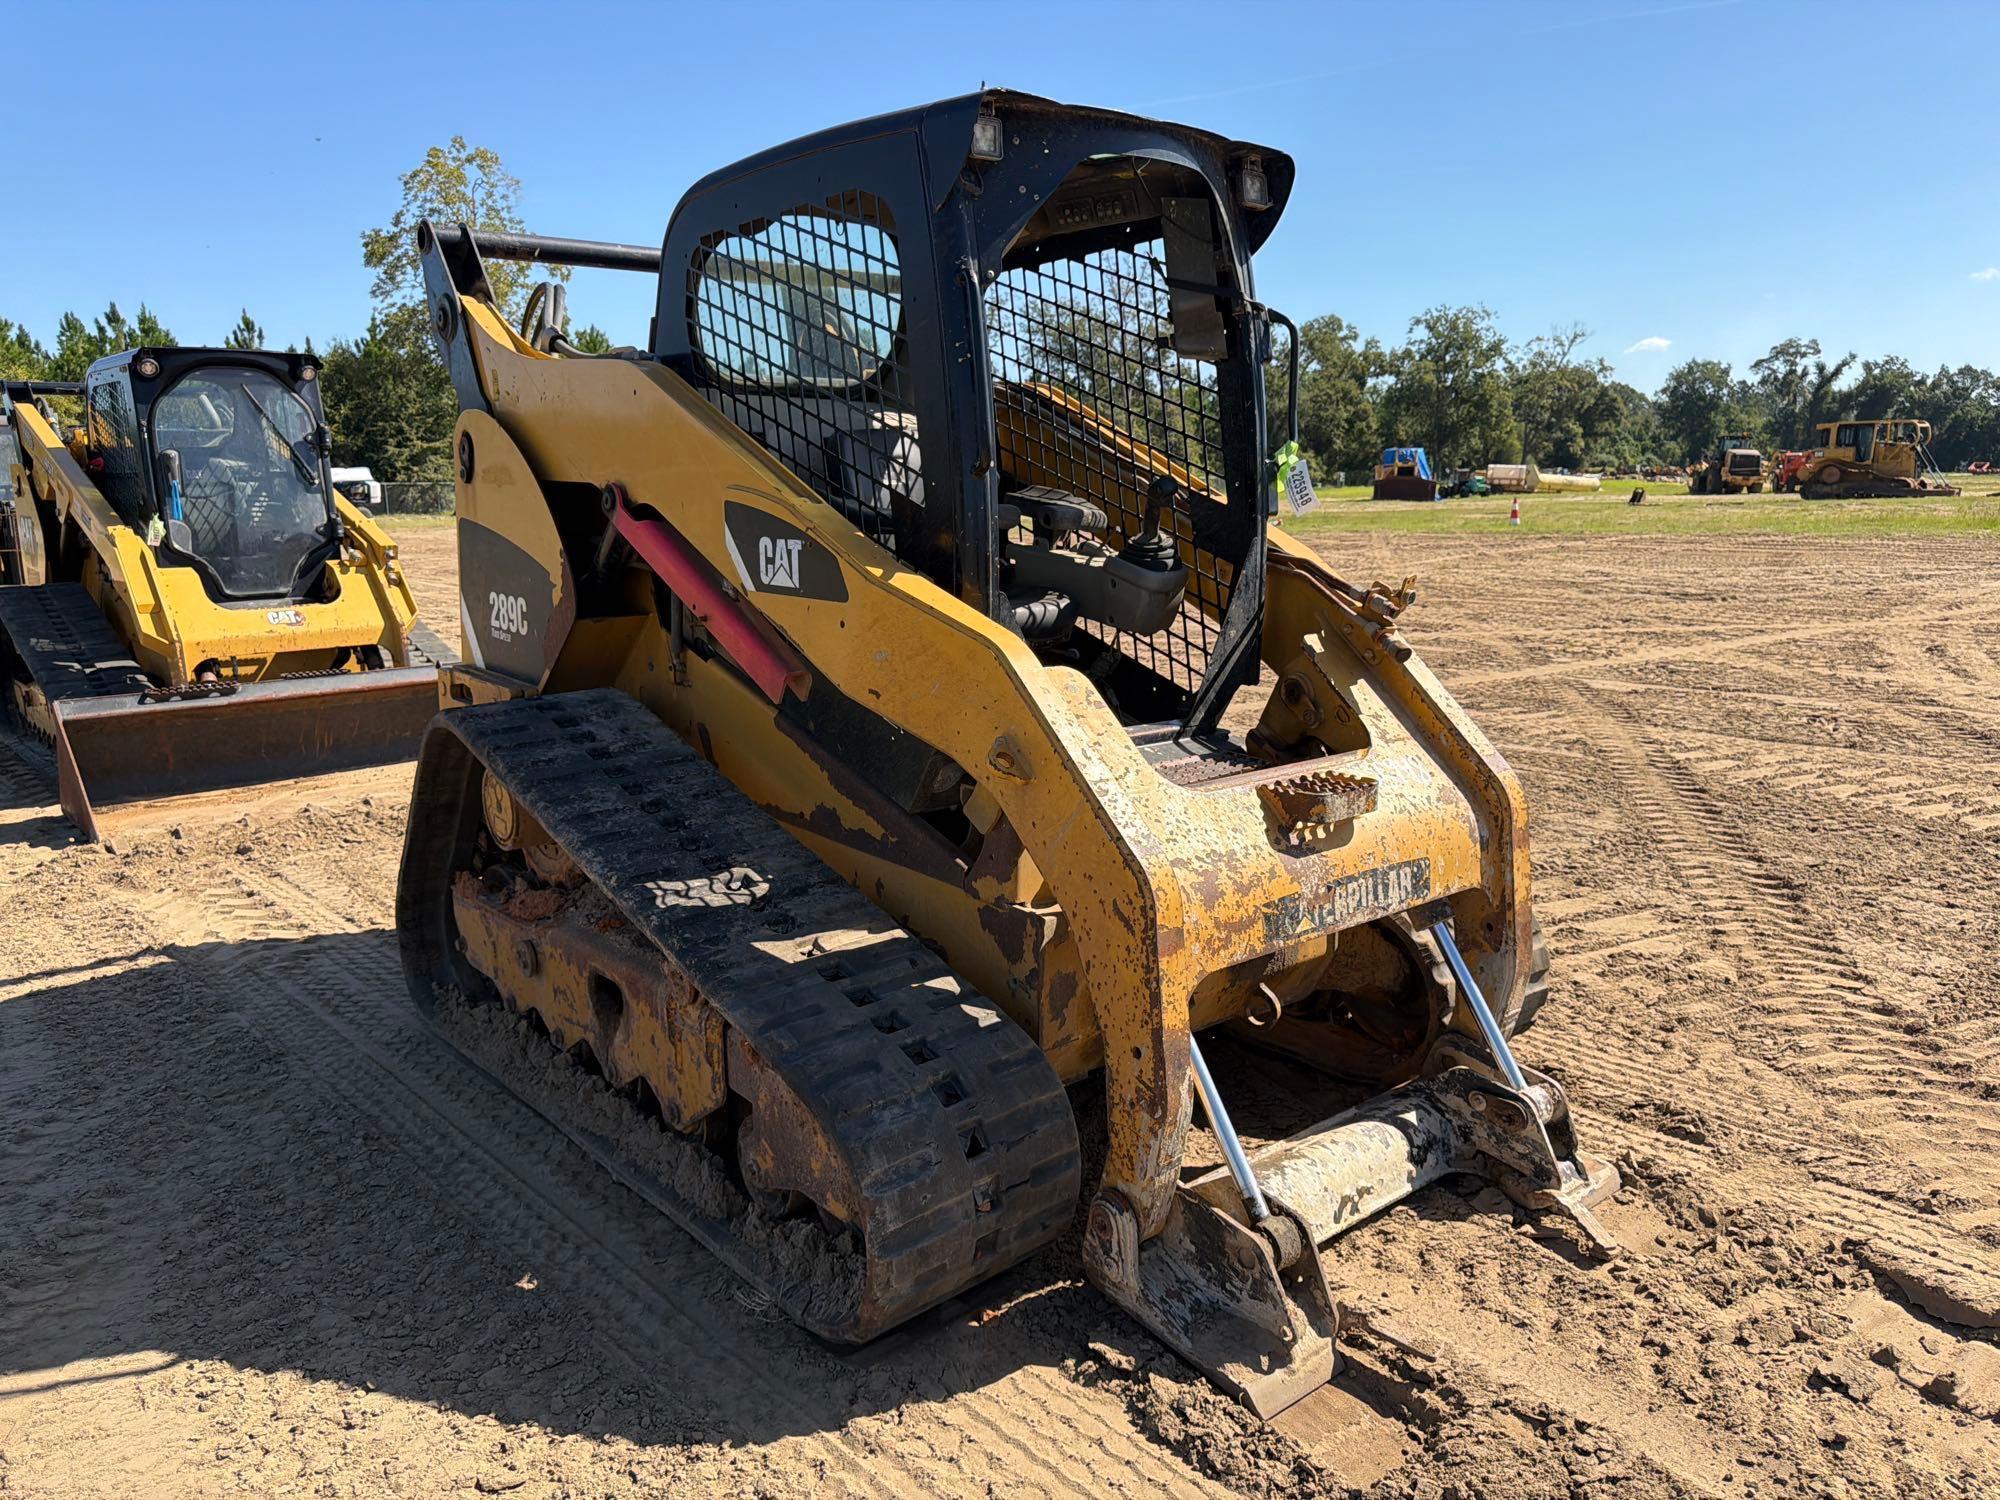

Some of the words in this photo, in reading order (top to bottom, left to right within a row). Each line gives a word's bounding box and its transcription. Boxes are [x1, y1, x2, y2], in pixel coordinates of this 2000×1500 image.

[1291, 470, 1312, 506] 225948
[758, 536, 802, 589] CAT
[267, 610, 297, 625] CAT
[489, 591, 528, 636] 289C
